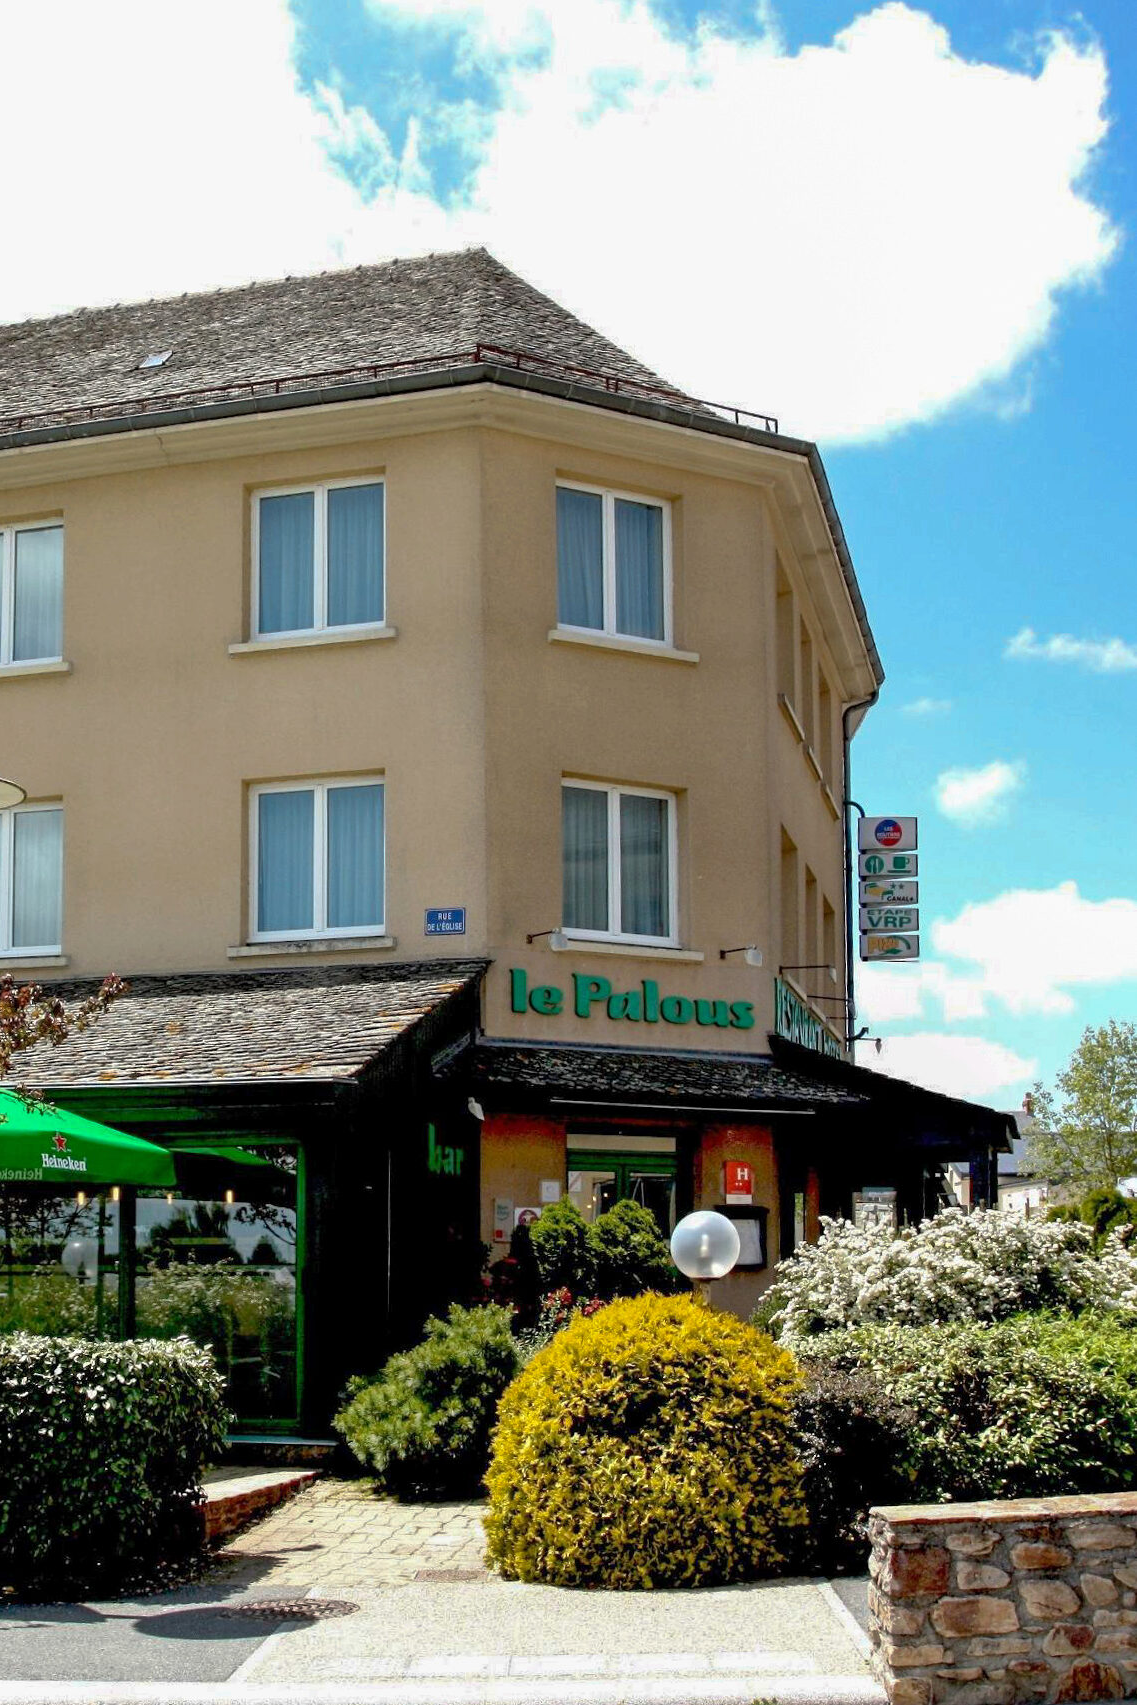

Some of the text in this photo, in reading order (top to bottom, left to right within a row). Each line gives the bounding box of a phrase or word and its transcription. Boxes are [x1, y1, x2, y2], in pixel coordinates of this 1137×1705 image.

[437, 912, 452, 920] RUE
[867, 916, 912, 928] VRP
[427, 923, 436, 931] DE
[509, 968, 756, 1029] le Palous
[427, 1122, 465, 1177] bar
[41, 1153, 87, 1172] Heineken
[736, 1167, 749, 1181] H
